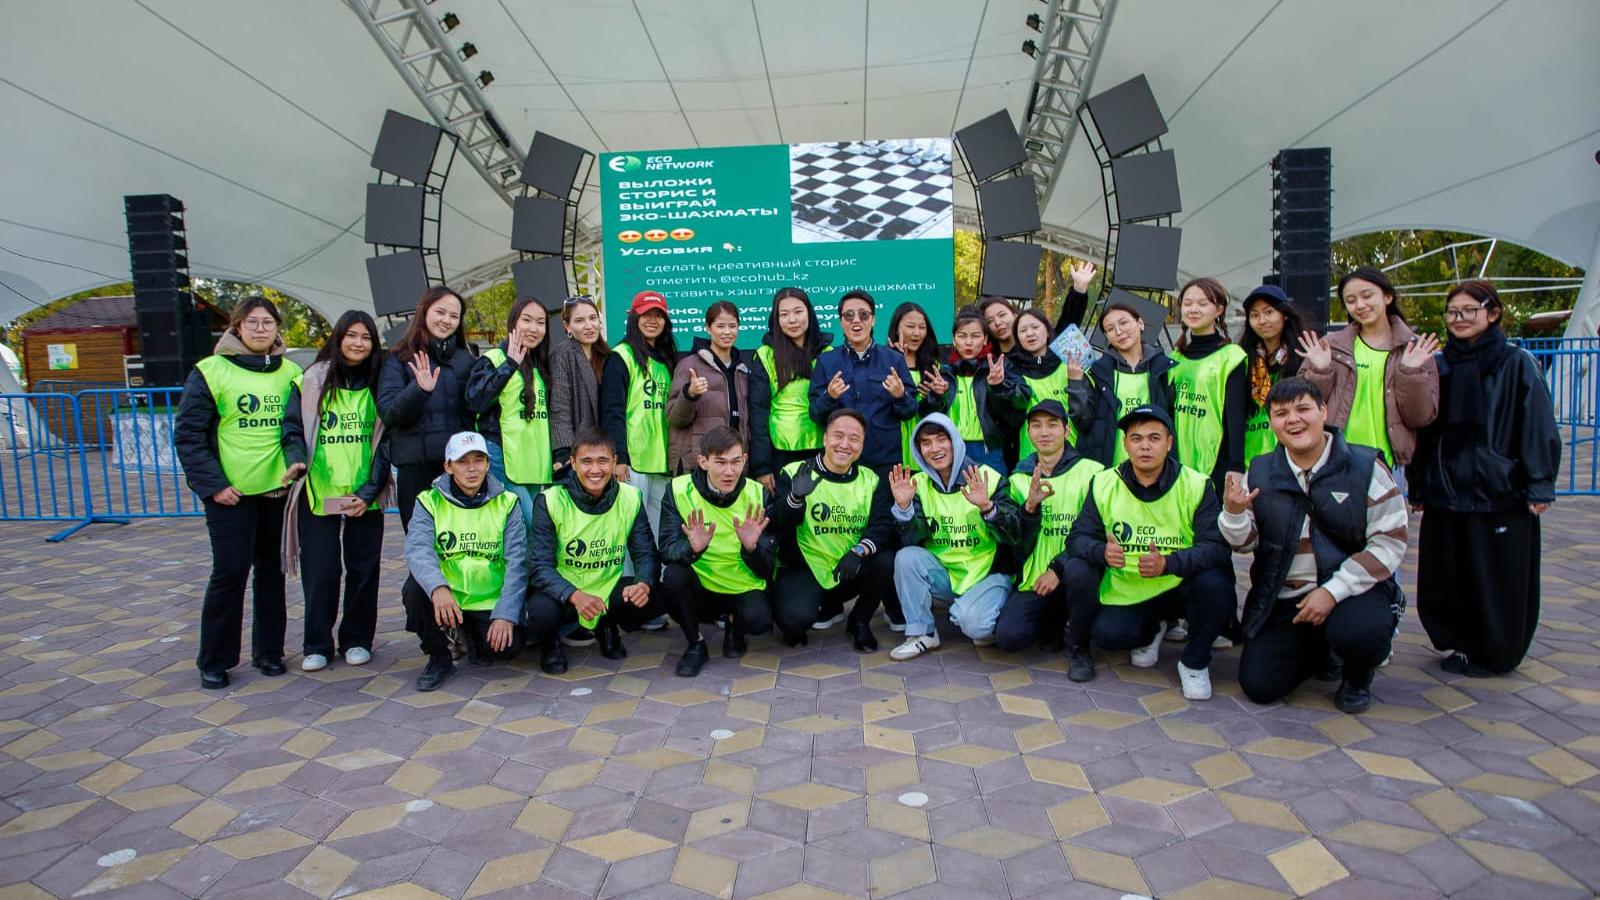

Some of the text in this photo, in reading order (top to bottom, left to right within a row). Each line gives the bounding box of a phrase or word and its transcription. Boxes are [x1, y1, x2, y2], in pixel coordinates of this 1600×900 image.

[646, 155, 673, 163] ECO
[645, 160, 714, 170] NETWORK
[618, 178, 712, 189] ВЫЛОЖИ
[618, 188, 716, 200] СТОРИС И
[619, 198, 717, 211] ВЫИГРАЙ
[619, 208, 778, 222] ЭКО-ШАХМАТЫ
[620, 246, 713, 256] Условия
[645, 258, 857, 273] сделать креативный сторис
[646, 272, 809, 286] отметить @ecohub_kz
[794, 283, 936, 296] хочуэкошахматы
[263, 395, 280, 403] ECO
[1125, 398, 1142, 406] ECO
[341, 412, 358, 421] ECO
[831, 506, 846, 514] ECO
[1136, 525, 1156, 535] ECO
[460, 533, 477, 541] ECO
[1135, 536, 1185, 545] NETWORK
[459, 542, 500, 551] NETWORK
[590, 539, 606, 548] ECO
[589, 544, 624, 557] NETWOR
